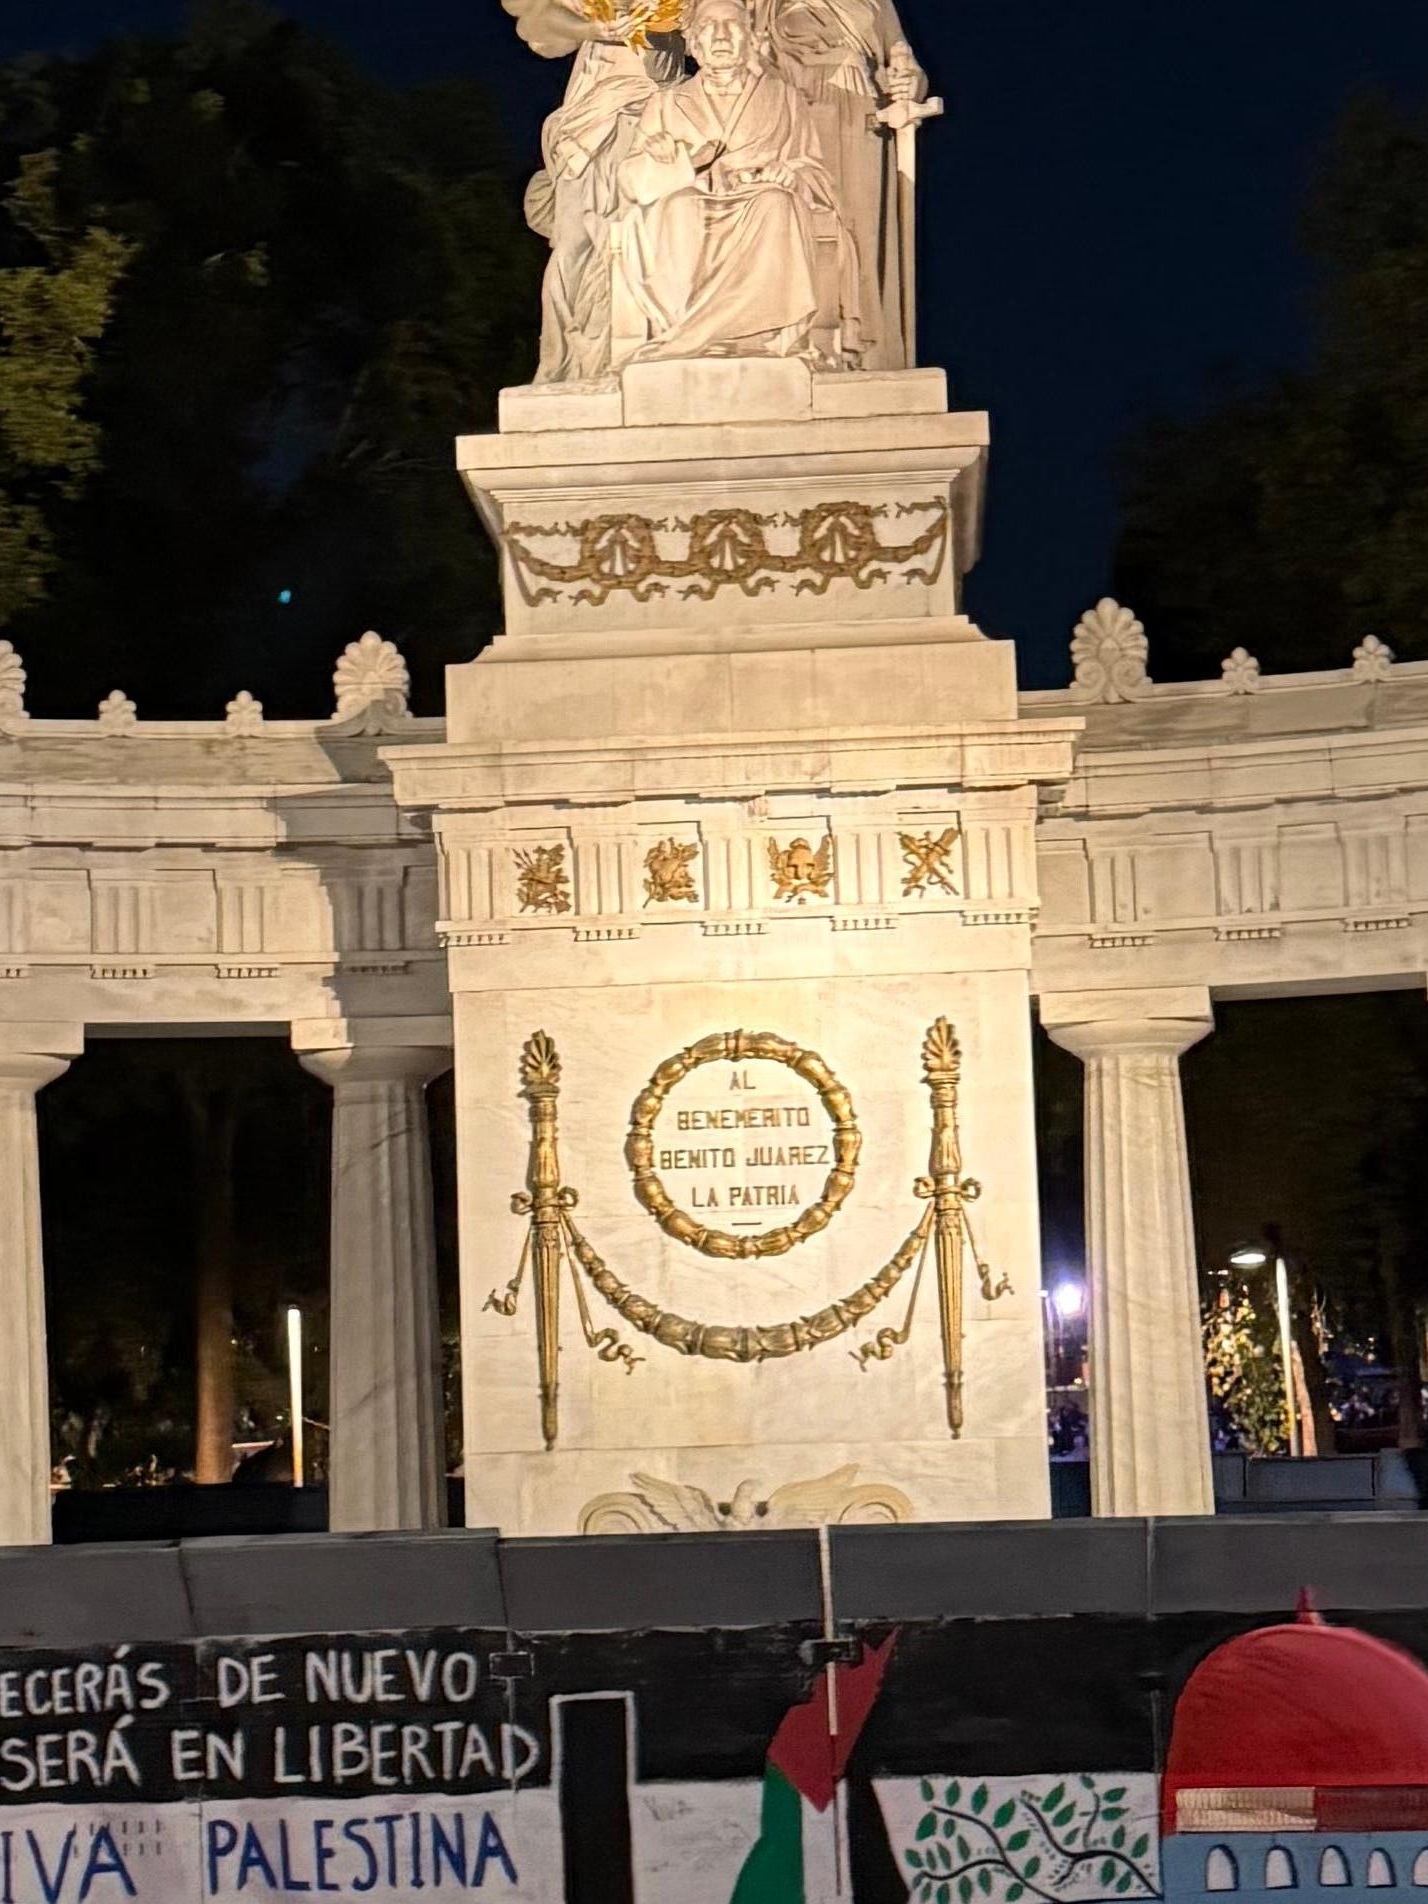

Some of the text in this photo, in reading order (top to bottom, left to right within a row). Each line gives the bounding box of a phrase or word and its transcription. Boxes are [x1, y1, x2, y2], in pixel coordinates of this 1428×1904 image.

[729, 1070, 756, 1090] AL
[677, 1107, 810, 1131] BENEMERITO
[660, 1145, 829, 1170] BENITO JUAREZ
[692, 1184, 800, 1208] LA PATRIA
[218, 1654, 285, 1708] DE
[305, 1649, 477, 1704] NUEVO
[0, 1714, 142, 1792] SERÁ
[171, 1729, 245, 1782] EN
[274, 1721, 541, 1786] LIBERTAD
[207, 1810, 519, 1896] PALESTINA
